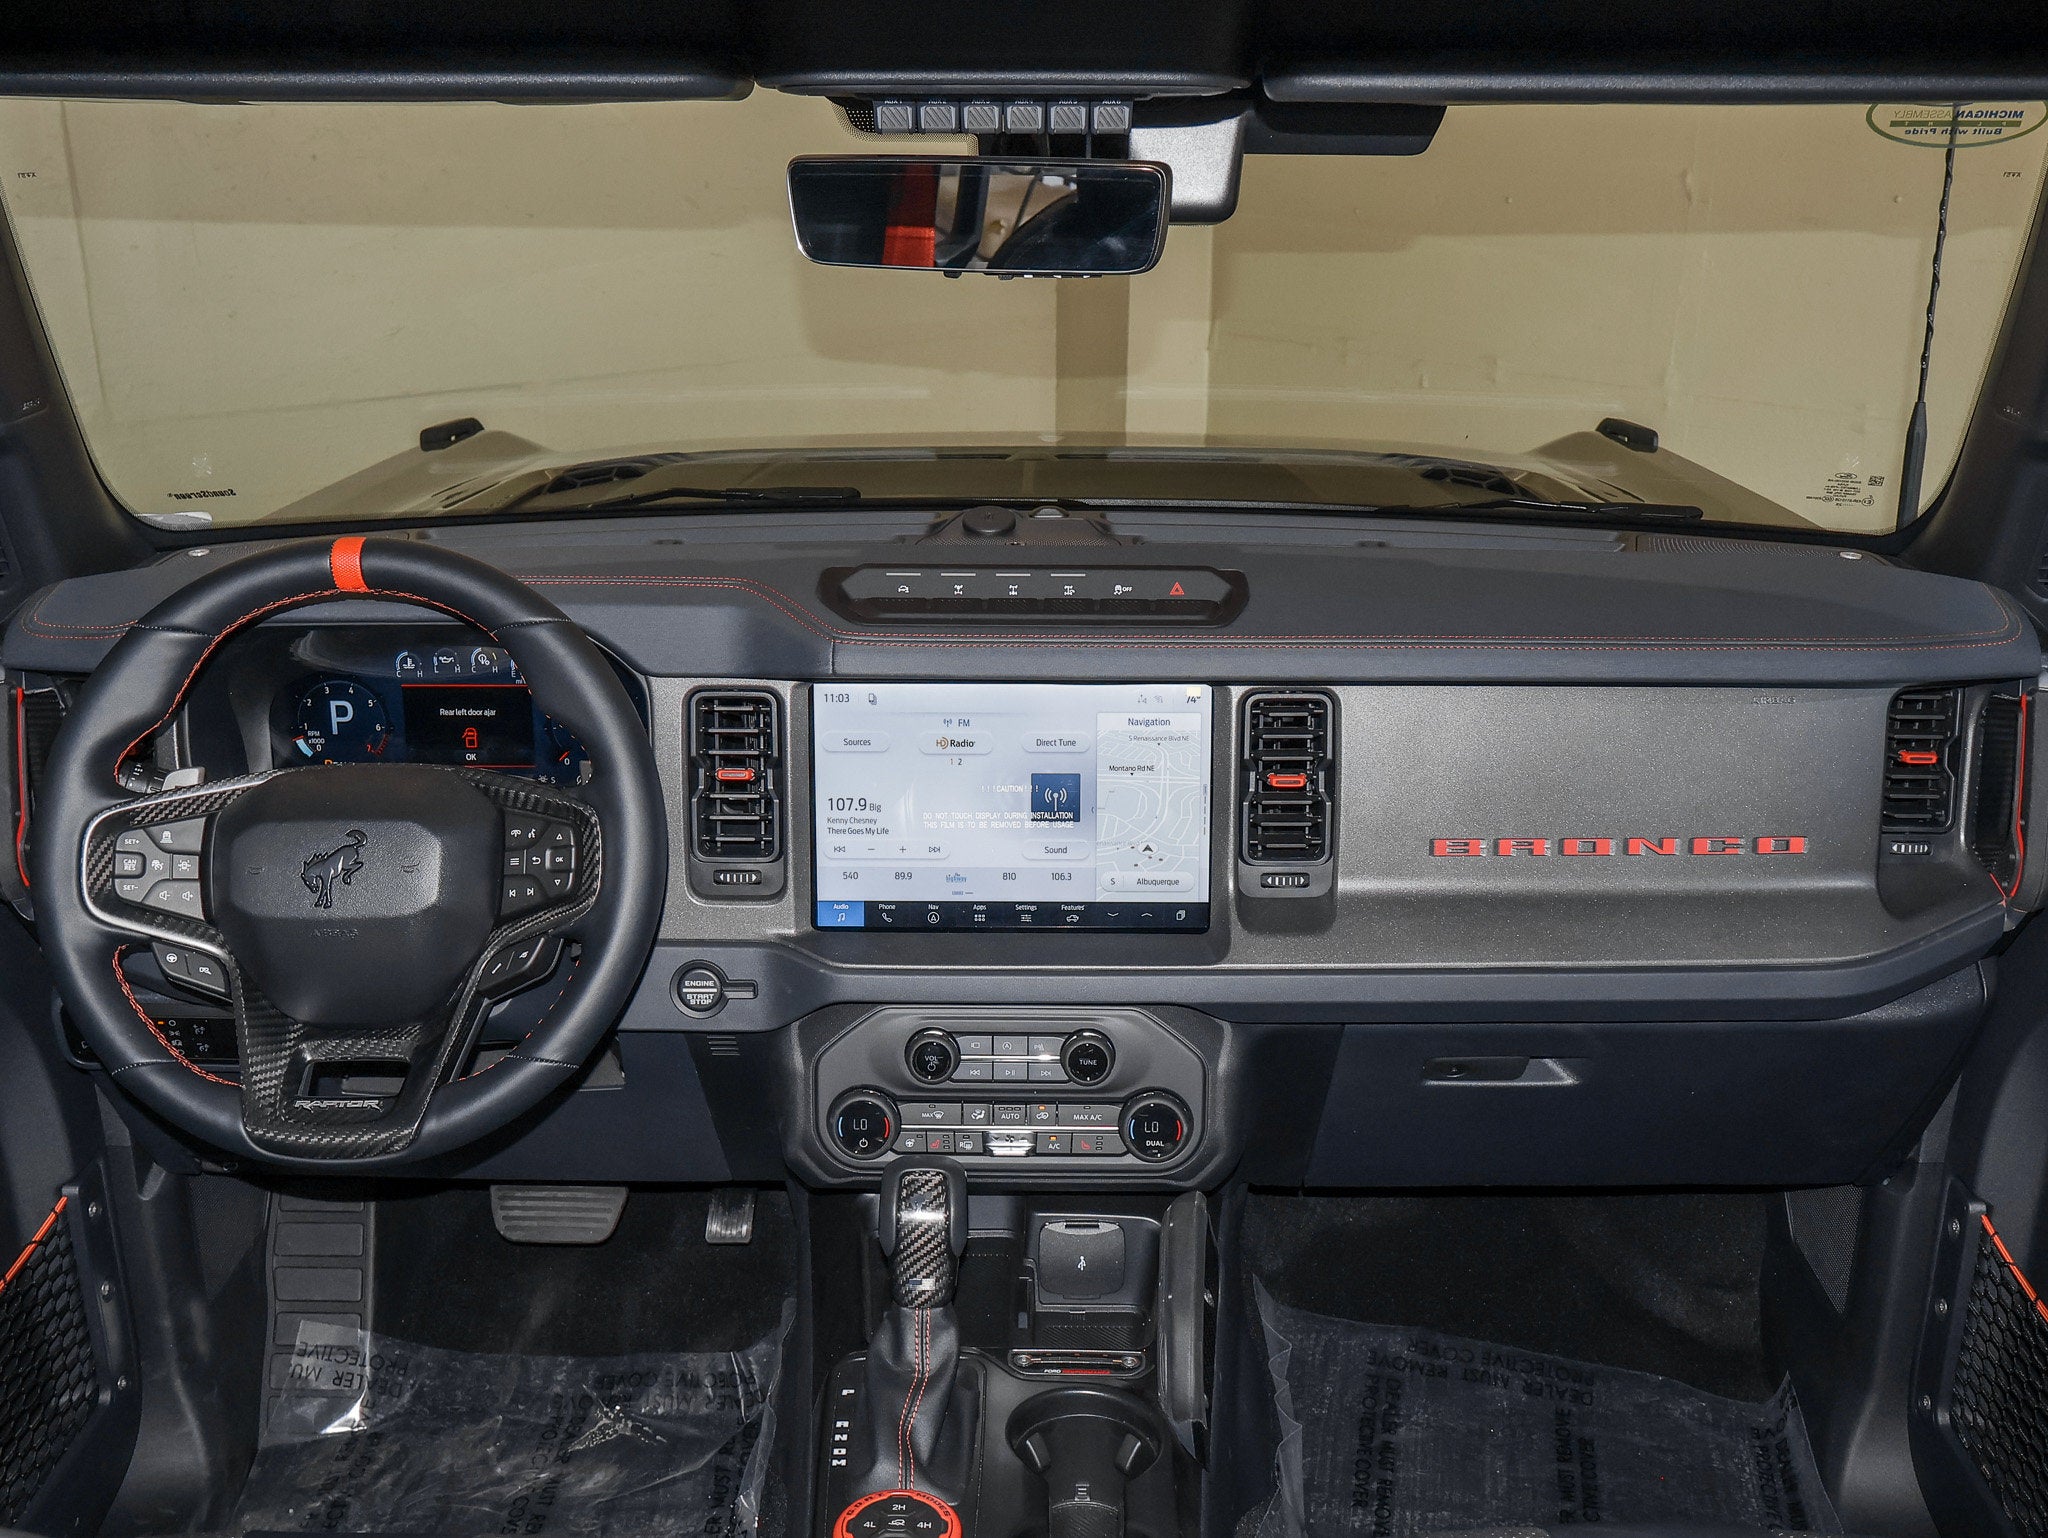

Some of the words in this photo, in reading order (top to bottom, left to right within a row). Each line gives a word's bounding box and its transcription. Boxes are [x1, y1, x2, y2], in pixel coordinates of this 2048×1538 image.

[824, 694, 850, 702] 11:03
[483, 708, 496, 717] ajar
[330, 700, 353, 735] P
[958, 719, 970, 727] FM
[1128, 718, 1170, 727] Navigation
[844, 738, 871, 746] Sources
[950, 739, 975, 748] Radio
[1036, 738, 1057, 747] Direct
[1059, 738, 1076, 747] Tune
[828, 798, 866, 811] 107.9
[869, 803, 881, 812] Big
[827, 817, 848, 825] Kenny
[849, 817, 877, 825] Chesney
[865, 828, 876, 836] My
[1430, 836, 1808, 857] BRONCO
[1136, 877, 1180, 886] Albuquerque
[294, 1100, 384, 1113] RAPTOR
[854, 1118, 867, 1131] LO
[1144, 1121, 1159, 1133] LO
[296, 1342, 409, 1376] PROTECTIVE
